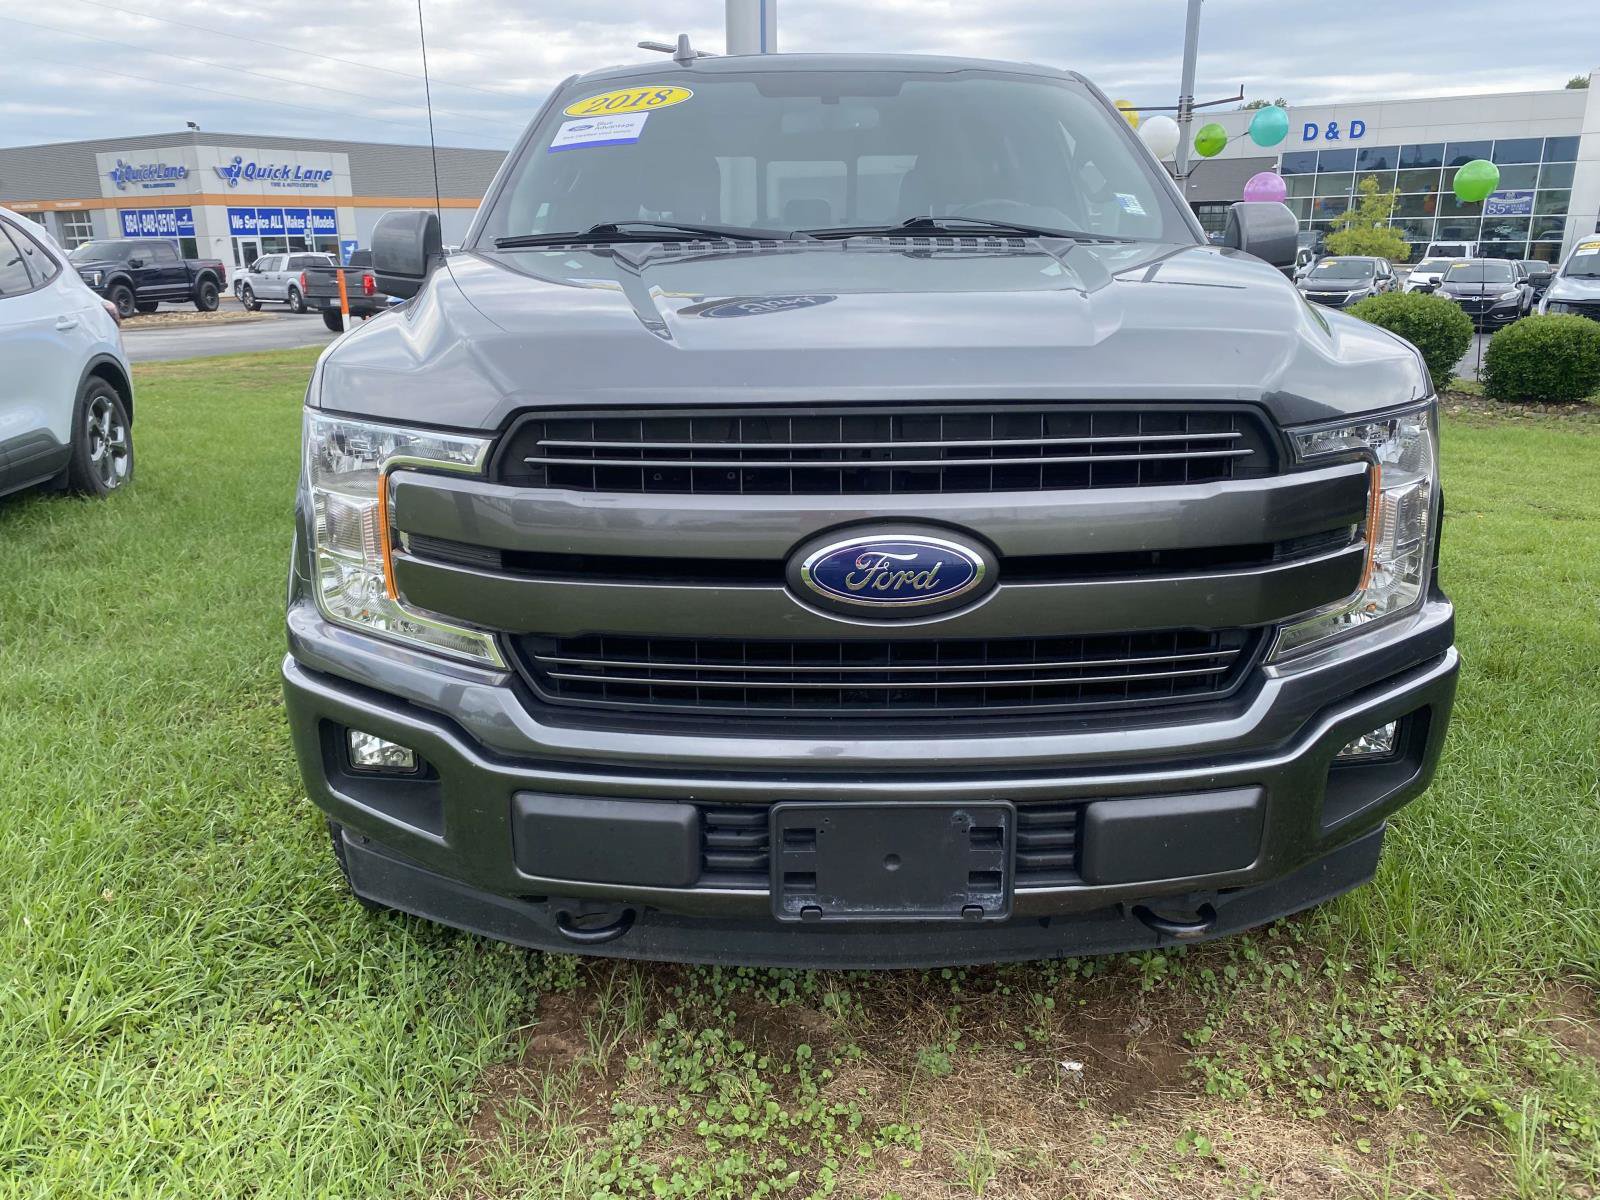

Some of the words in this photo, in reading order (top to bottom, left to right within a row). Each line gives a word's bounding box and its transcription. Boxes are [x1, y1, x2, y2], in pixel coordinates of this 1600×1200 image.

[581, 88, 674, 114] 2018
[1303, 123, 1319, 142] D
[1325, 122, 1340, 141] &
[1349, 120, 1367, 139] D
[124, 164, 157, 182] Quick
[156, 163, 187, 180] Lane
[243, 162, 292, 181] Quick
[294, 164, 334, 182] Lane
[231, 215, 244, 228] We
[244, 215, 269, 228] Service
[270, 215, 283, 228] ALL
[284, 215, 305, 228] Makes
[313, 215, 335, 228] Models
[845, 551, 943, 591] Ford
